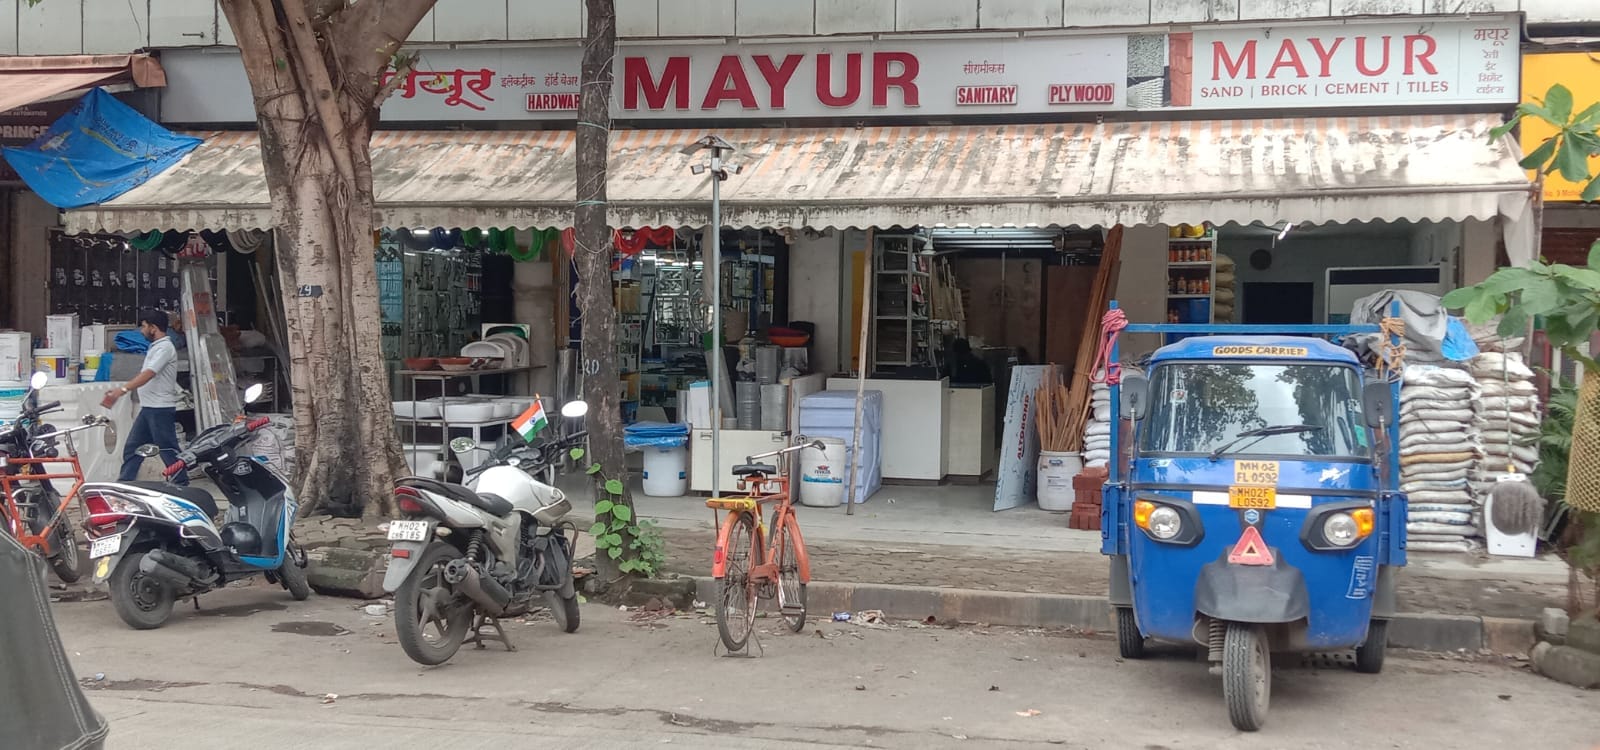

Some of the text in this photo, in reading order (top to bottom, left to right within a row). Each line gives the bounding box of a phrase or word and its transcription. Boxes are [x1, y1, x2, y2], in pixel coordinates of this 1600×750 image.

[1473, 27, 1510, 46] मयूर
[1212, 34, 1439, 80] MAYUR
[623, 51, 921, 111] MAYUR
[958, 87, 1015, 104] SANITARY
[1201, 81, 1449, 98] SAND BRICK CEMENT TILES
[527, 94, 580, 110] HARDWAR
[1214, 346, 1305, 356] GOODS CARRIER
[1017, 394, 1030, 461] ALTOBOND
[1240, 462, 1276, 472] MH 02
[1236, 473, 1278, 484] FL 0592
[1237, 488, 1269, 498] MH02F
[1237, 498, 1270, 508] L0592
